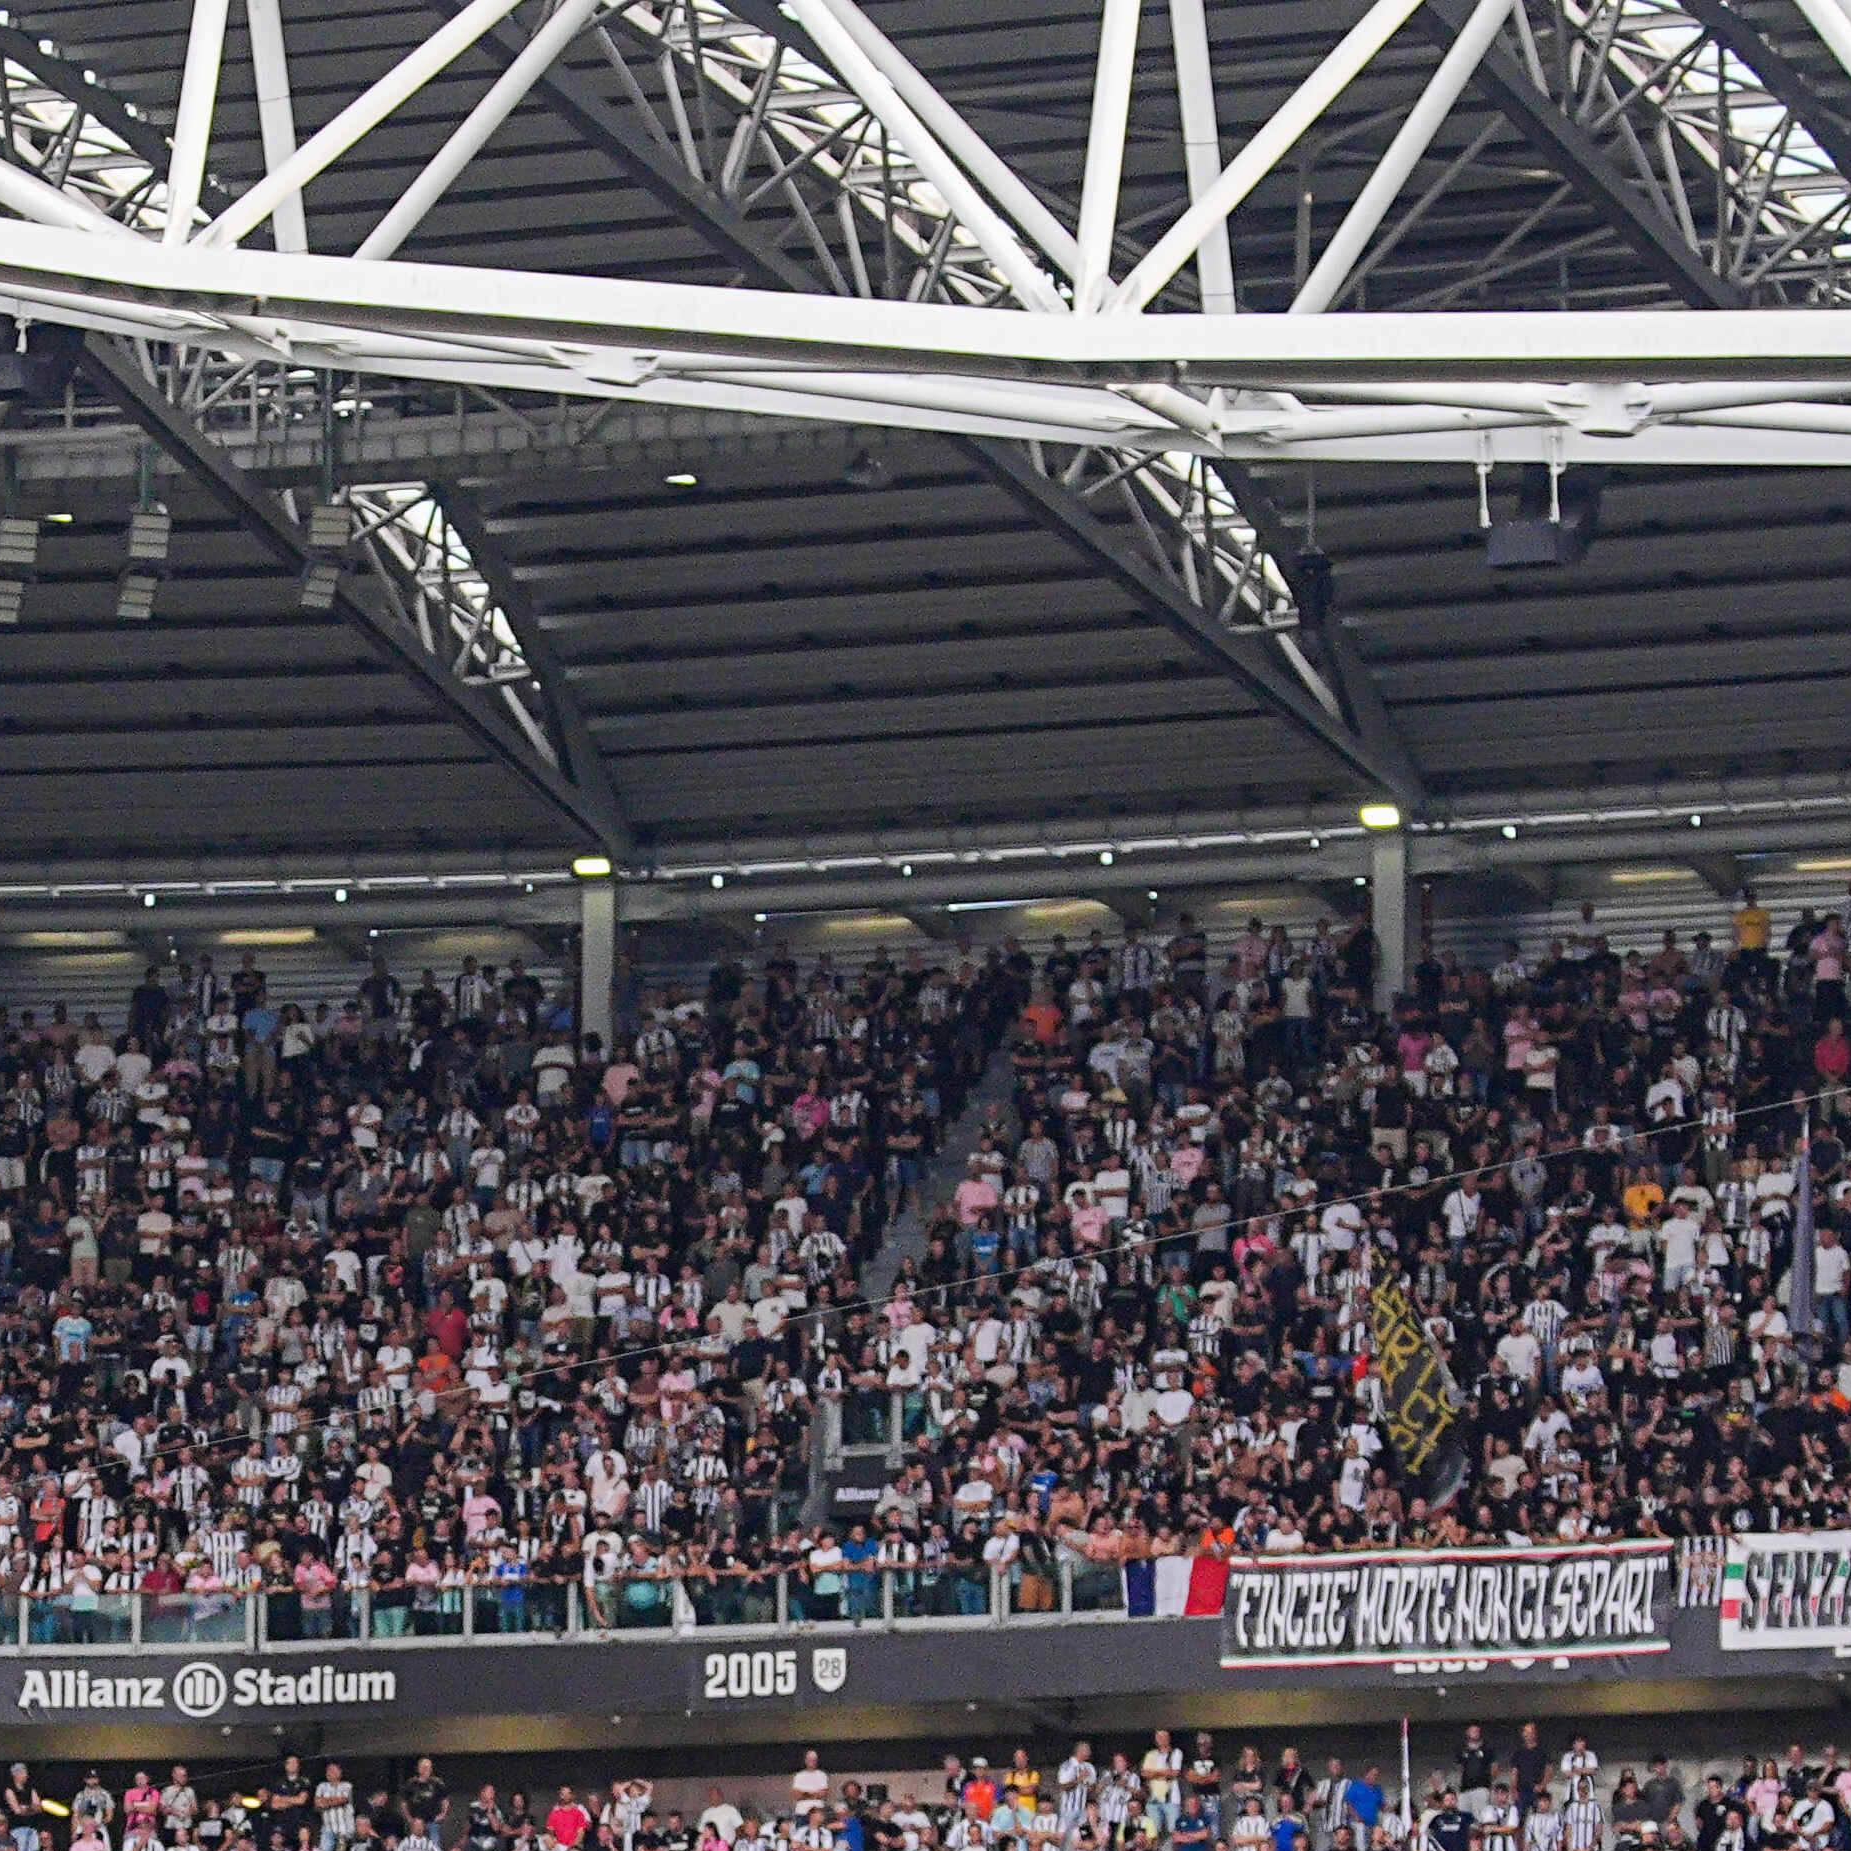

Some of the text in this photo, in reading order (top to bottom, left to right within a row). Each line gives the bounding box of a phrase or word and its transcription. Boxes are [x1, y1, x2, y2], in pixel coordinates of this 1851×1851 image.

[1352, 1564, 1456, 1647] MORTE
[1454, 1563, 1516, 1642] NON
[1515, 1564, 1550, 1640] CI
[18, 1666, 396, 1709] Allianz Stadium
[705, 1651, 842, 1698] 2005 28
